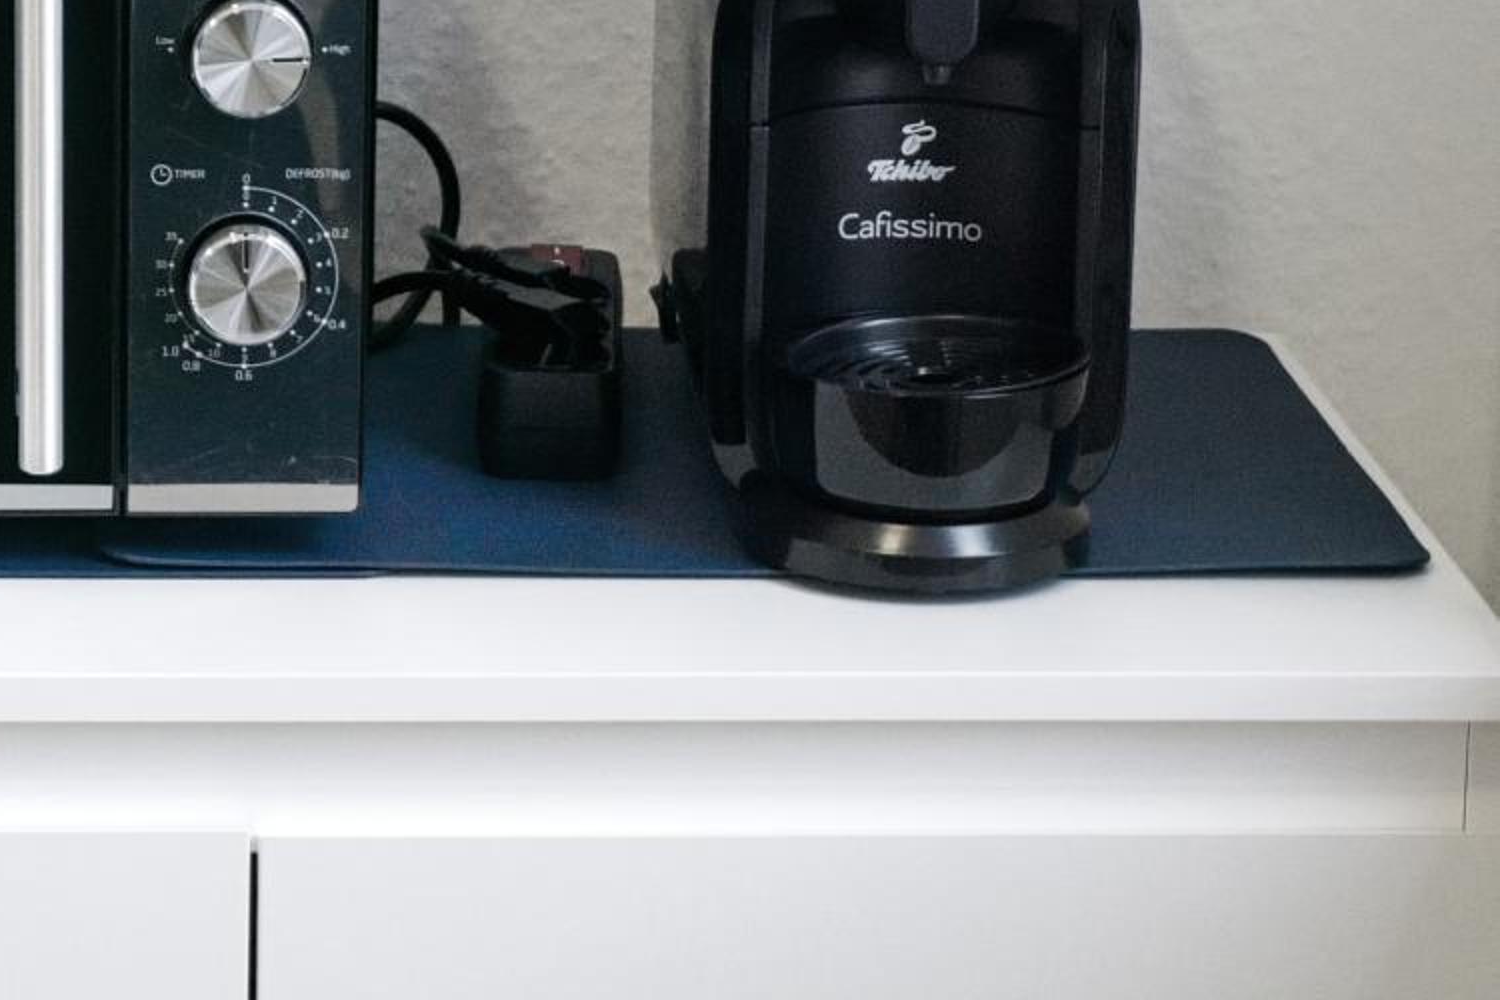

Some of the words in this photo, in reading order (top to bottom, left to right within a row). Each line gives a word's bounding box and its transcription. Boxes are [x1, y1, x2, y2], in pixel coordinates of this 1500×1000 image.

[156, 36, 174, 45] Low
[175, 168, 205, 179] TIMER
[285, 168, 351, 180] DEFROSTING
[867, 159, 956, 182] Tchibo
[837, 210, 983, 242] Cafissimo
[331, 228, 349, 239] 0.2
[327, 319, 346, 331] 0.4
[162, 345, 179, 357] 1.0
